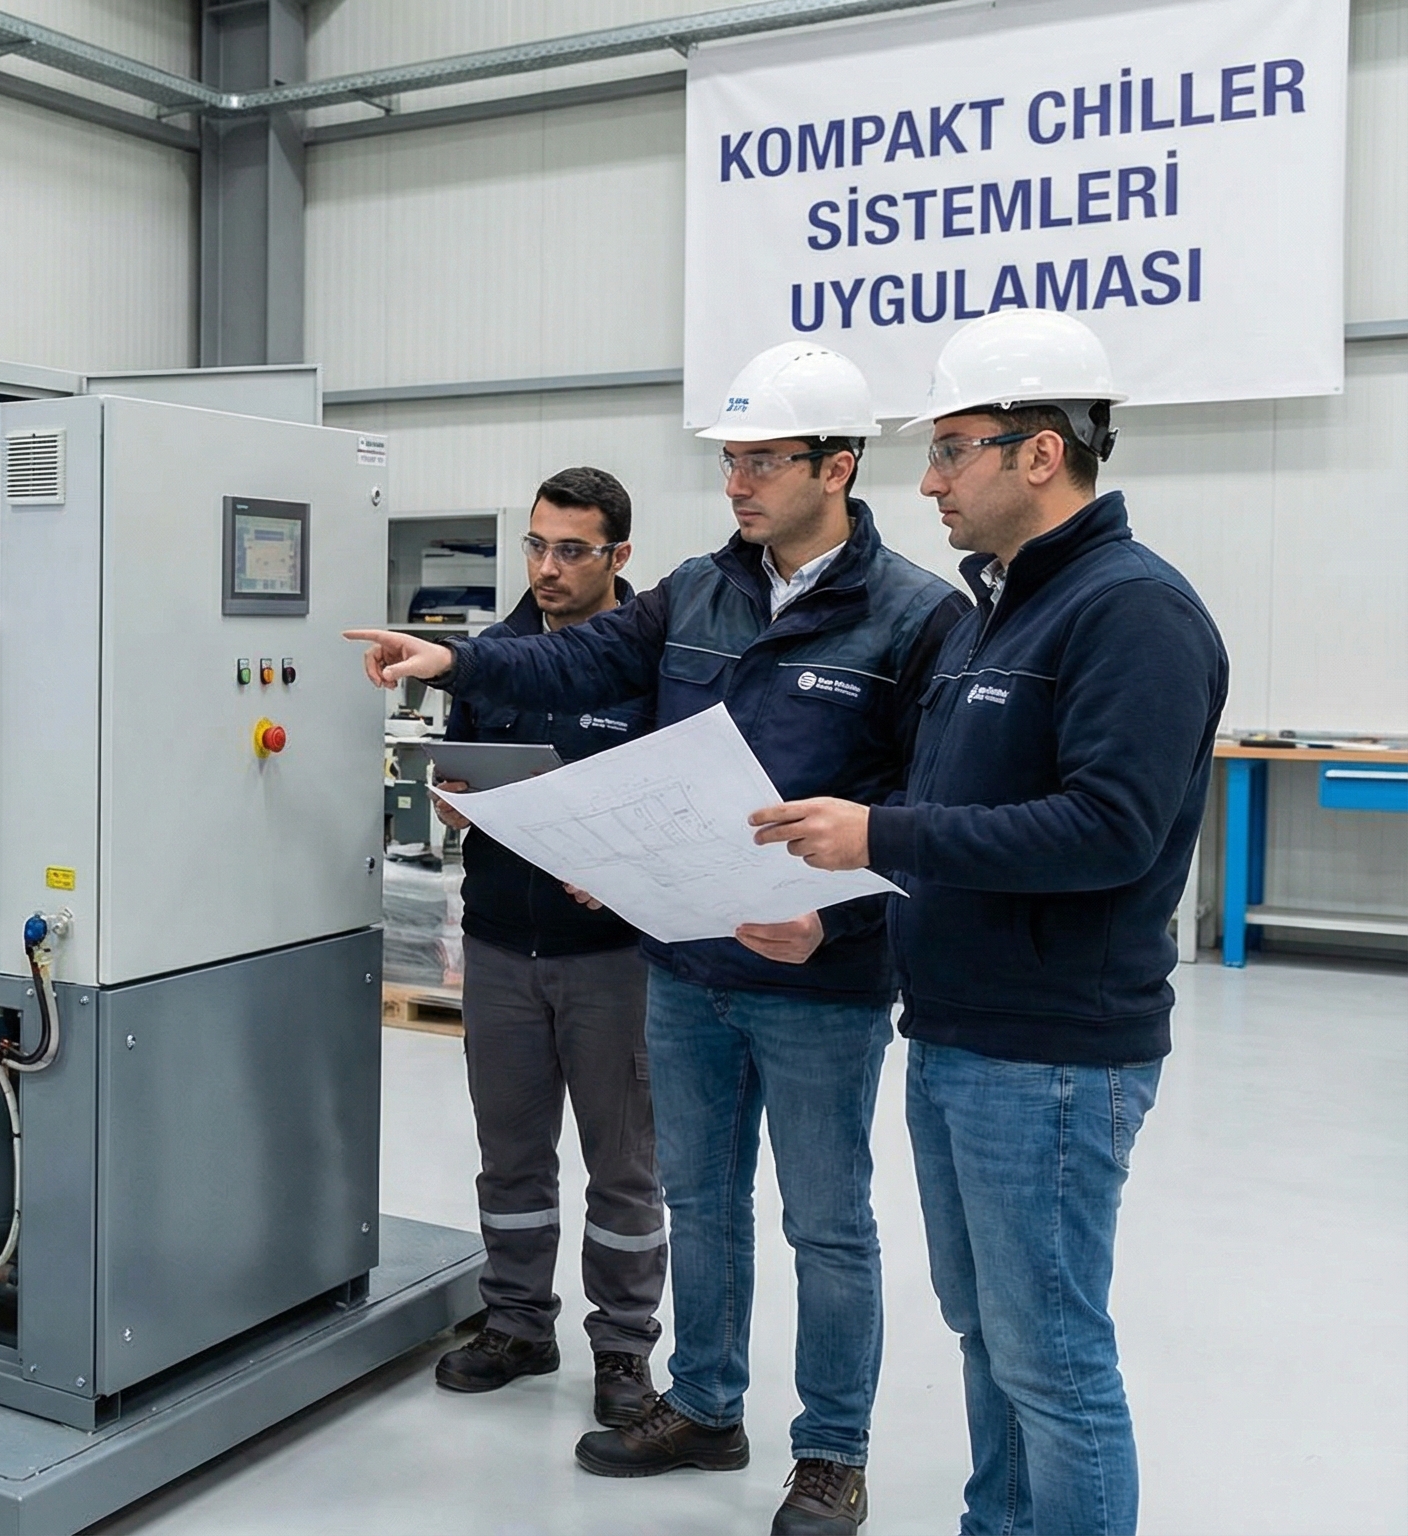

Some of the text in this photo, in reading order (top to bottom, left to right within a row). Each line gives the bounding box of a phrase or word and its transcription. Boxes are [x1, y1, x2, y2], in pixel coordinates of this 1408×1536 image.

[720, 58, 1306, 183] KOMPAKT CHİLLER
[807, 149, 1178, 251] SİSTEMLERİ
[791, 247, 1202, 333] UYGULAMASI
